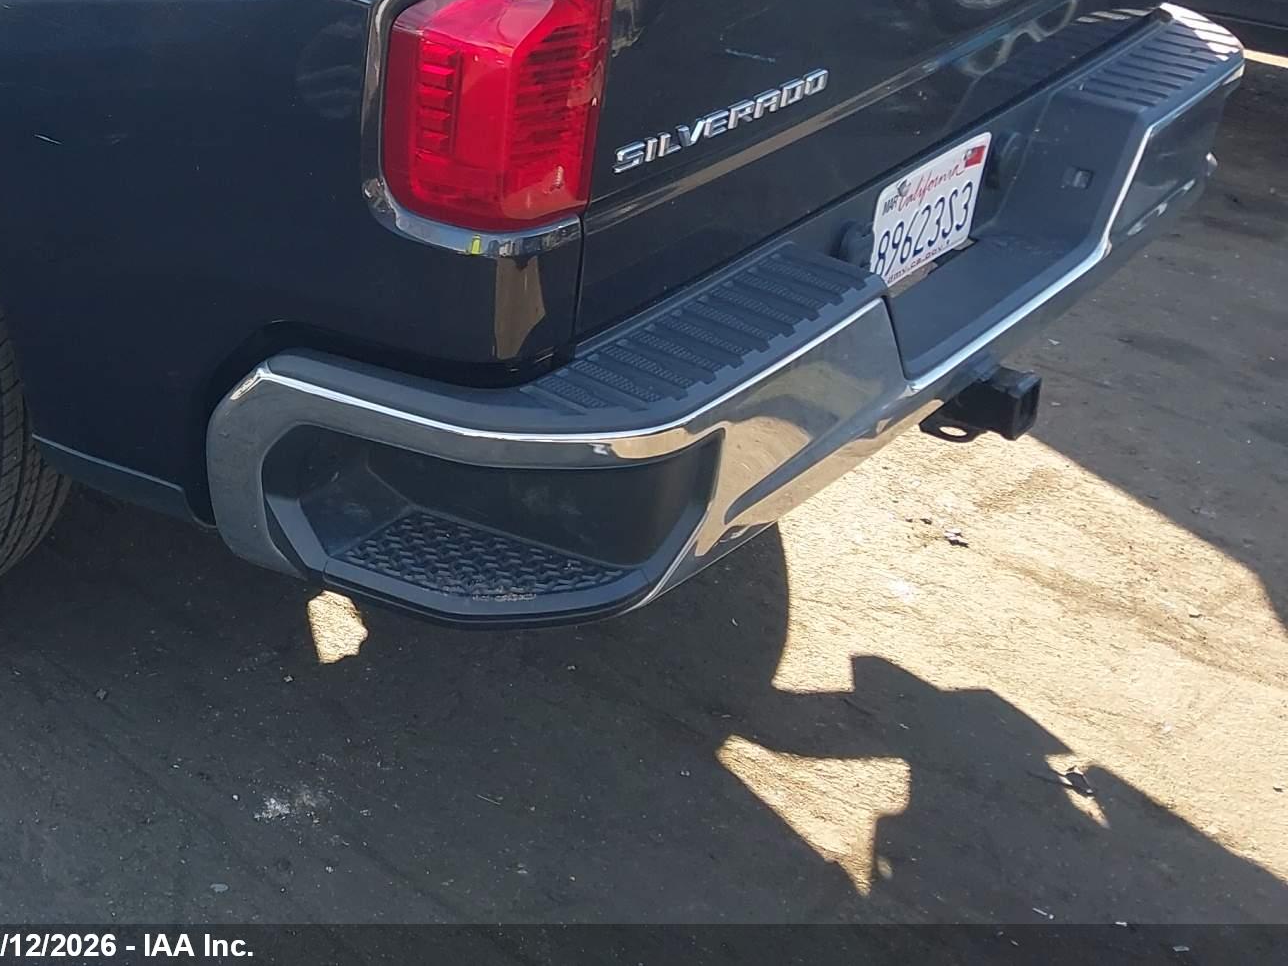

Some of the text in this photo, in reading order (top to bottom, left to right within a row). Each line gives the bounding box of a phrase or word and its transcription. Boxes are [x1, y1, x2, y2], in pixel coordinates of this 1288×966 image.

[612, 68, 830, 174] SILVERADO
[882, 164, 965, 216] MAR California
